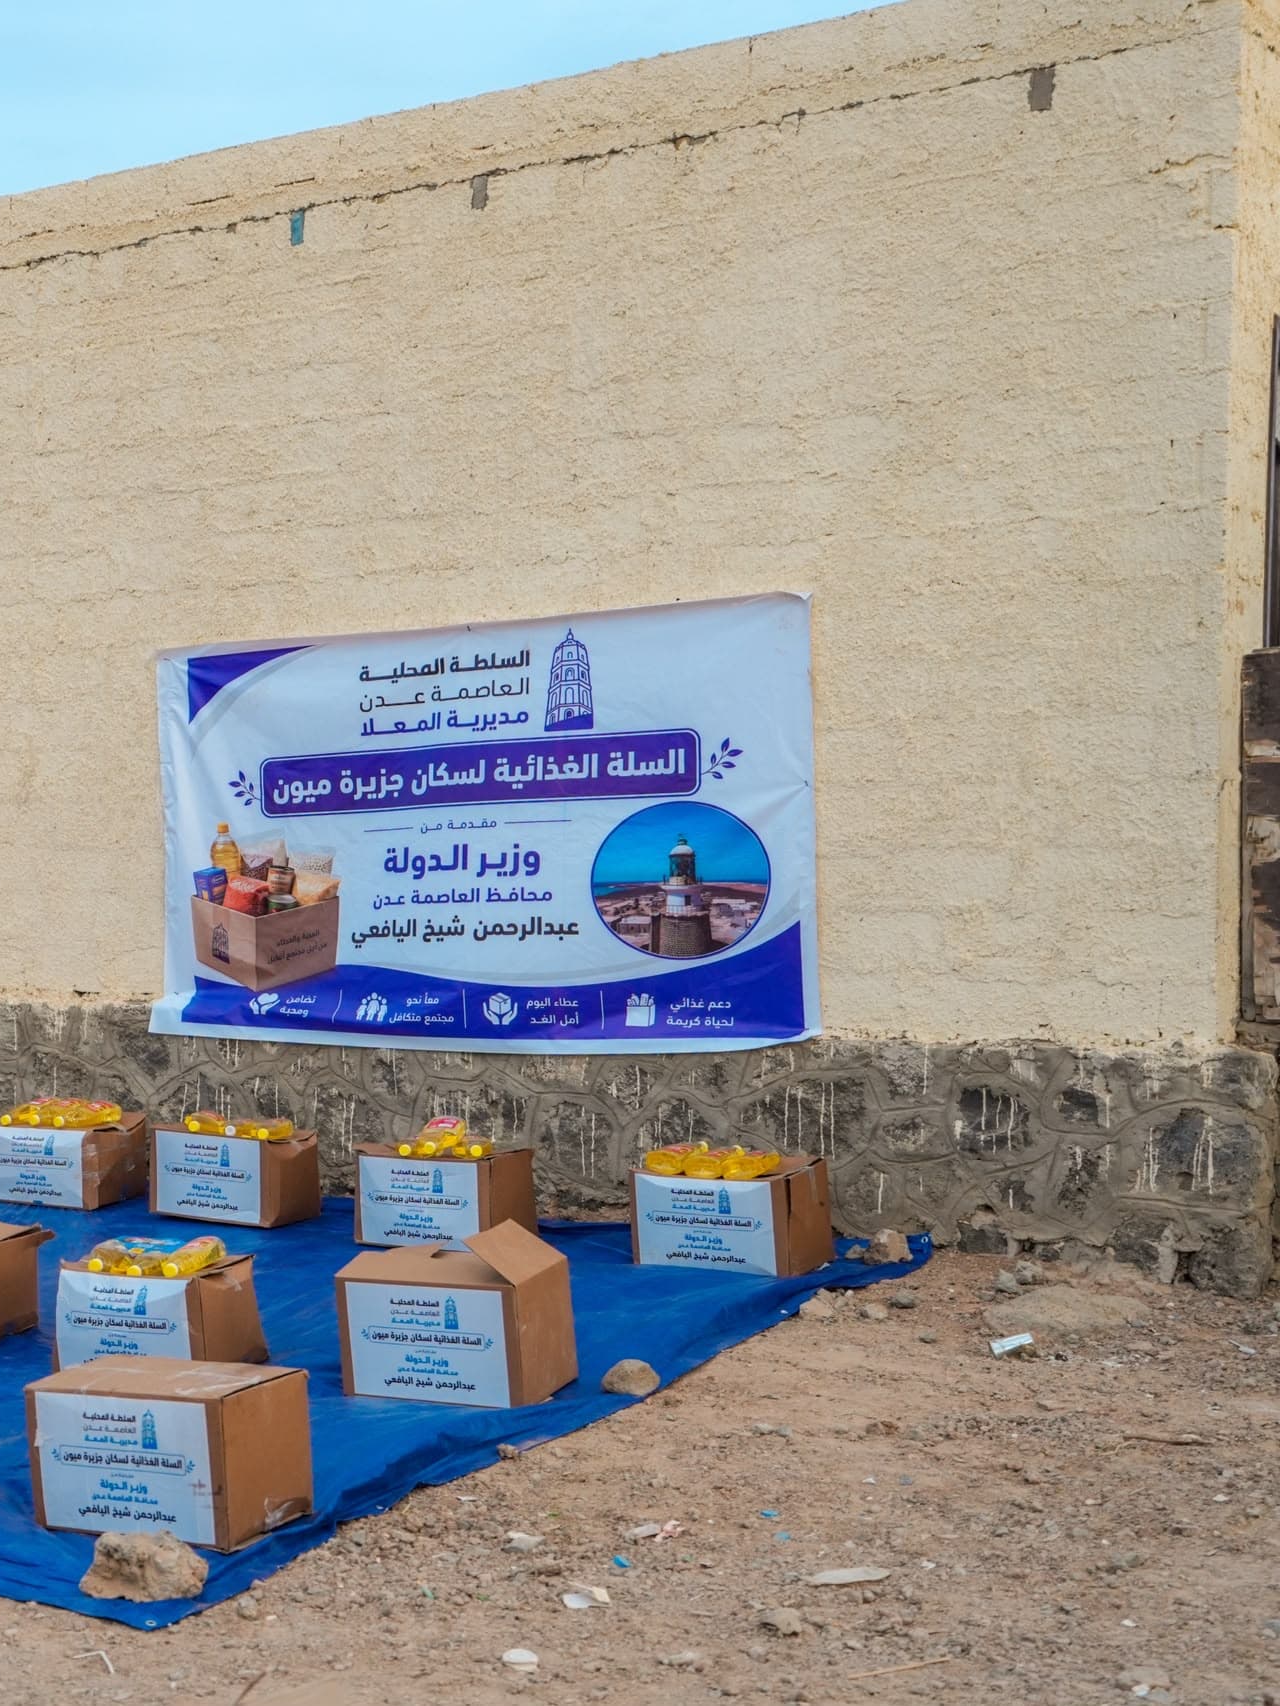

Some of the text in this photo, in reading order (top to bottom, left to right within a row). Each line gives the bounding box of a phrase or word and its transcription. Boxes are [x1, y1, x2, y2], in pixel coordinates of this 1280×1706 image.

[359, 650, 530, 683] السلطة المحلية
[360, 677, 530, 712] العاصمة عدن
[360, 710, 529, 736] مديرية المعلا
[273, 748, 685, 804] السلة الغذائية لسكان جزيرة ميون
[420, 818, 497, 834] مقدمة من
[384, 843, 541, 880] وزير الدولة
[373, 887, 552, 910] محافظ العاصمة عدن
[351, 915, 579, 949] عبدالرحمن شيخ اليافعي
[286, 995, 316, 1004] تضامن
[406, 996, 422, 1007] نحو
[526, 997, 579, 1008] عطاء اليوم
[670, 997, 731, 1012] دعم غذائي
[389, 1013, 454, 1025] مجتمع متكافل
[530, 1012, 579, 1025] أمل الغد
[666, 1016, 734, 1028] لحياة كريمة
[371, 1331, 482, 1345] السلة الغذائية لسكان جزيرة ميون
[384, 1376, 476, 1392] عبدالرحمن شيخ اليافعي
[63, 1451, 183, 1469] السلة الغذائية لسكان جزيرة ميون
[78, 1504, 177, 1524] عبدالرحمن شيخ اليافعي
